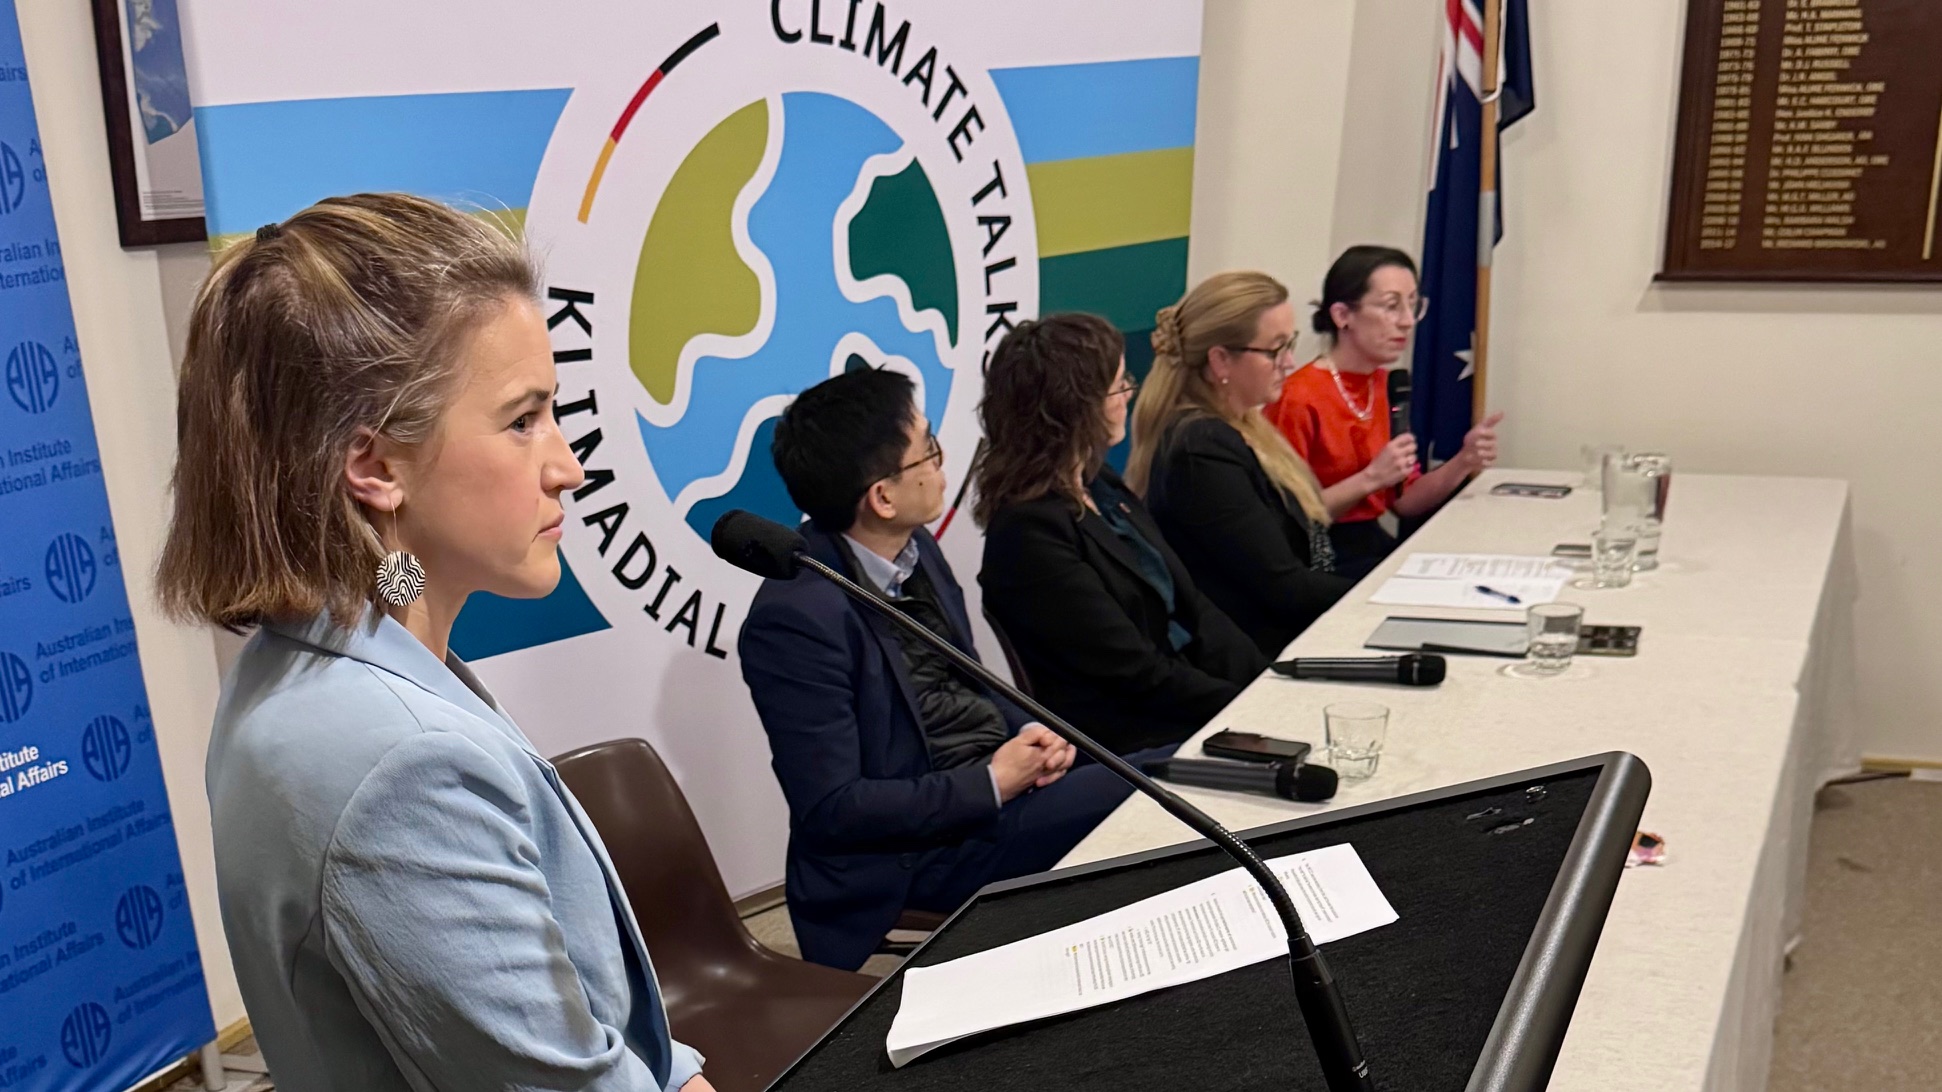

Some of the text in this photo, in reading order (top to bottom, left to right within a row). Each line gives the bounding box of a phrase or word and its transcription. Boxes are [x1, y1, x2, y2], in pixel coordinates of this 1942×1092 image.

[771, 0, 1018, 378] CLIMATE TALK
[8, 439, 72, 467] Institute
[51, 457, 101, 483] Affairs
[36, 625, 112, 660] Australian
[39, 663, 56, 684] of
[17, 760, 69, 792] Affairs
[6, 823, 85, 868] Australian
[10, 869, 27, 891] of
[29, 828, 123, 882] International
[13, 921, 77, 962] Institute
[55, 931, 105, 968] Affairs
